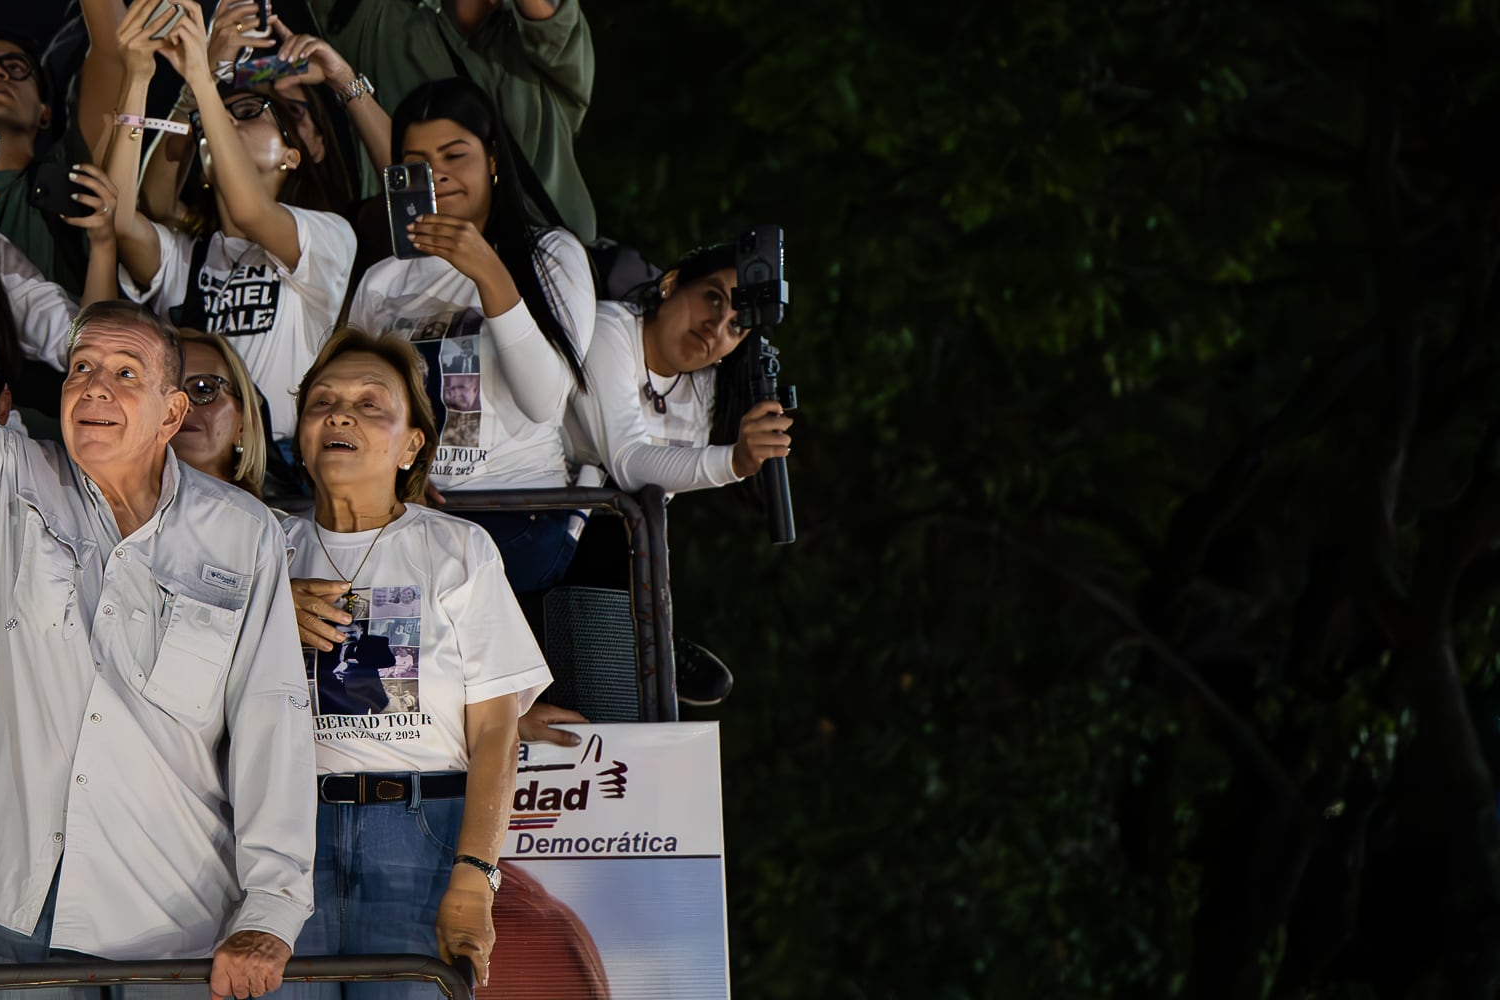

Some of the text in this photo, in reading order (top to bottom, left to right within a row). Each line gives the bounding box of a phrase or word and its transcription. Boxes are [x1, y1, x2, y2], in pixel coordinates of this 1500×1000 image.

[451, 448, 488, 463] TOUR
[385, 713, 432, 728] TOUR
[395, 729, 421, 740] 2024
[516, 832, 678, 854] Democrática
